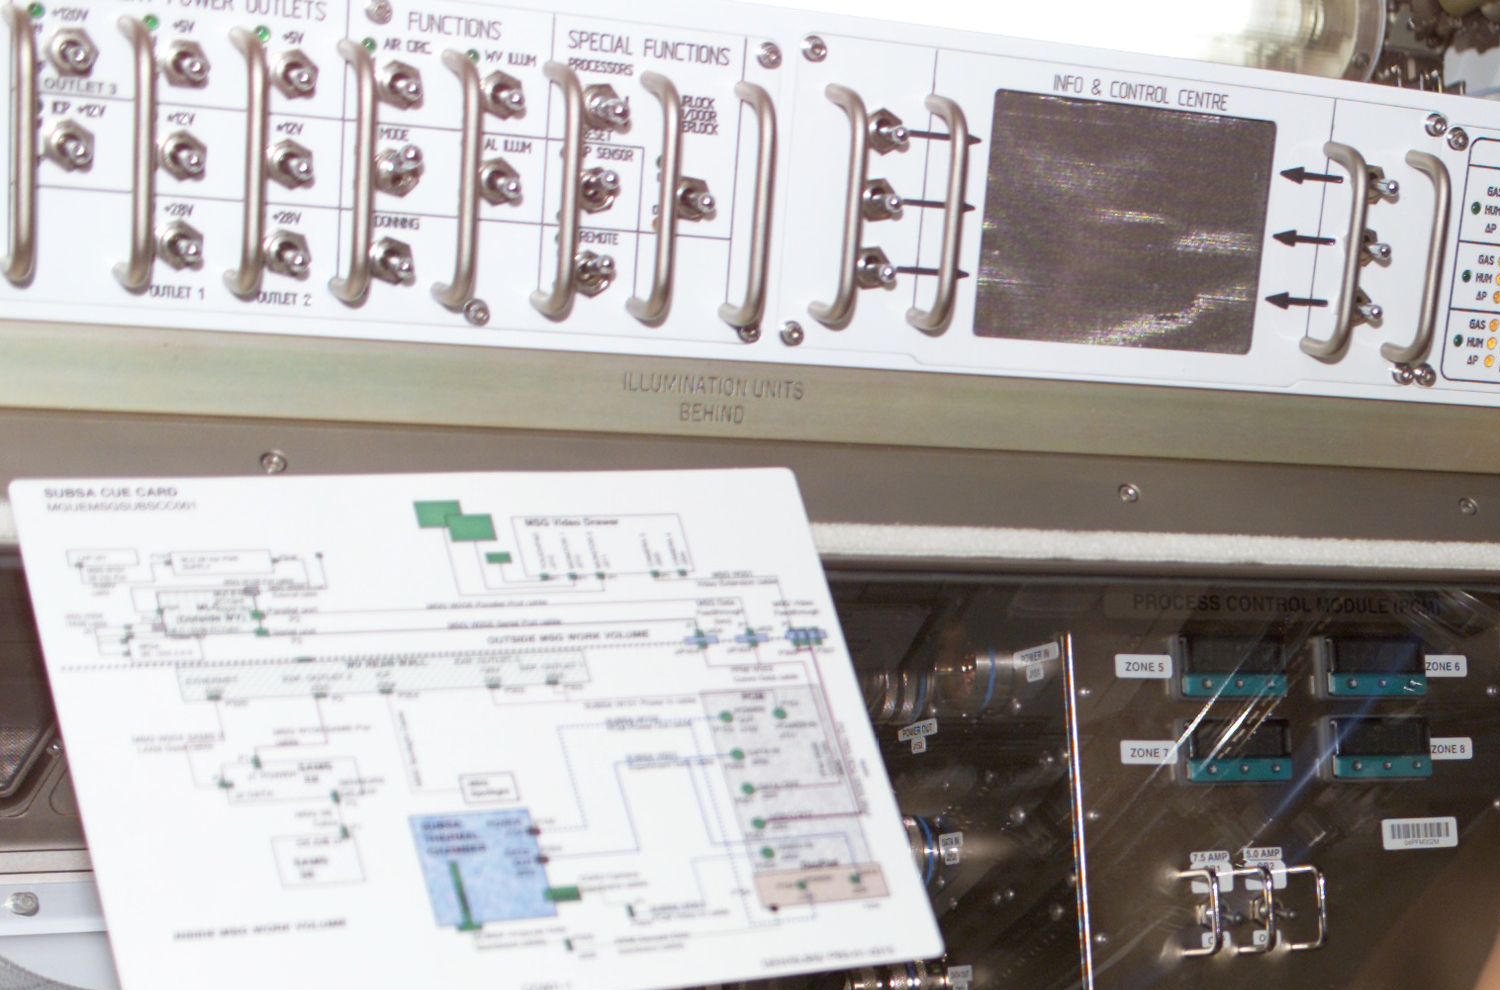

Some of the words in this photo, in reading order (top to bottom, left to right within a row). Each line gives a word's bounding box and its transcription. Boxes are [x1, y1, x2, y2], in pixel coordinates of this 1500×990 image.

[408, 11, 502, 41] FUNCTIONS
[383, 38, 401, 50] AIR
[568, 30, 633, 56] SPECIAL
[643, 38, 731, 66] FUNCTIONS
[568, 58, 633, 76] PROCESSORS
[43, 77, 105, 95] OUTLET
[109, 83, 118, 96] 3
[1053, 74, 1083, 94] INFO
[1091, 80, 1102, 95] &
[1110, 81, 1170, 104] CONTROL
[1178, 89, 1229, 112] CENTRE
[378, 128, 409, 142] MODE
[484, 139, 498, 151] AL
[596, 148, 634, 162] SENSOR
[163, 203, 195, 218] +28V
[272, 211, 302, 226] +28V
[374, 214, 420, 231] DONNING
[579, 230, 619, 247] REMOTE
[1478, 254, 1495, 265] GAS
[1475, 273, 1493, 284] HUM
[198, 288, 205, 301] 1
[302, 294, 313, 307] 2
[1469, 319, 1486, 330] GAS
[1467, 337, 1484, 348] HUM
[623, 371, 748, 397] ILLUMINATION
[752, 379, 804, 401] UNITS
[679, 402, 745, 425] BEHIND
[43, 487, 95, 499] SUBSA
[100, 487, 131, 499] CUE
[135, 487, 179, 498] CARD
[552, 517, 581, 527] Video
[583, 517, 619, 527] Drawer
[1133, 593, 1221, 611] PROCESS
[1226, 595, 1313, 613] CONTROL
[1315, 597, 1389, 615] MODULE
[487, 635, 536, 645] OUTSIDE
[539, 633, 564, 643] MSG
[567, 632, 600, 641] WORK
[603, 630, 649, 640] VOLUME
[1125, 661, 1154, 673] ZONE
[1158, 661, 1165, 673] 5
[1425, 661, 1451, 672] ZONE
[1454, 661, 1461, 672] 6
[902, 726, 921, 738] POWER
[921, 723, 933, 734] OUT
[1130, 747, 1158, 760] ZONE
[1162, 747, 1170, 759] 7
[1431, 744, 1456, 755] ZONE
[1459, 743, 1466, 754] 8
[1193, 853, 1206, 862] 7.5
[1208, 852, 1228, 861] AMP
[1246, 849, 1259, 859] 5.0
[1261, 849, 1280, 858] AMP
[252, 923, 291, 936] WORK
[295, 918, 348, 932] VOLUME
